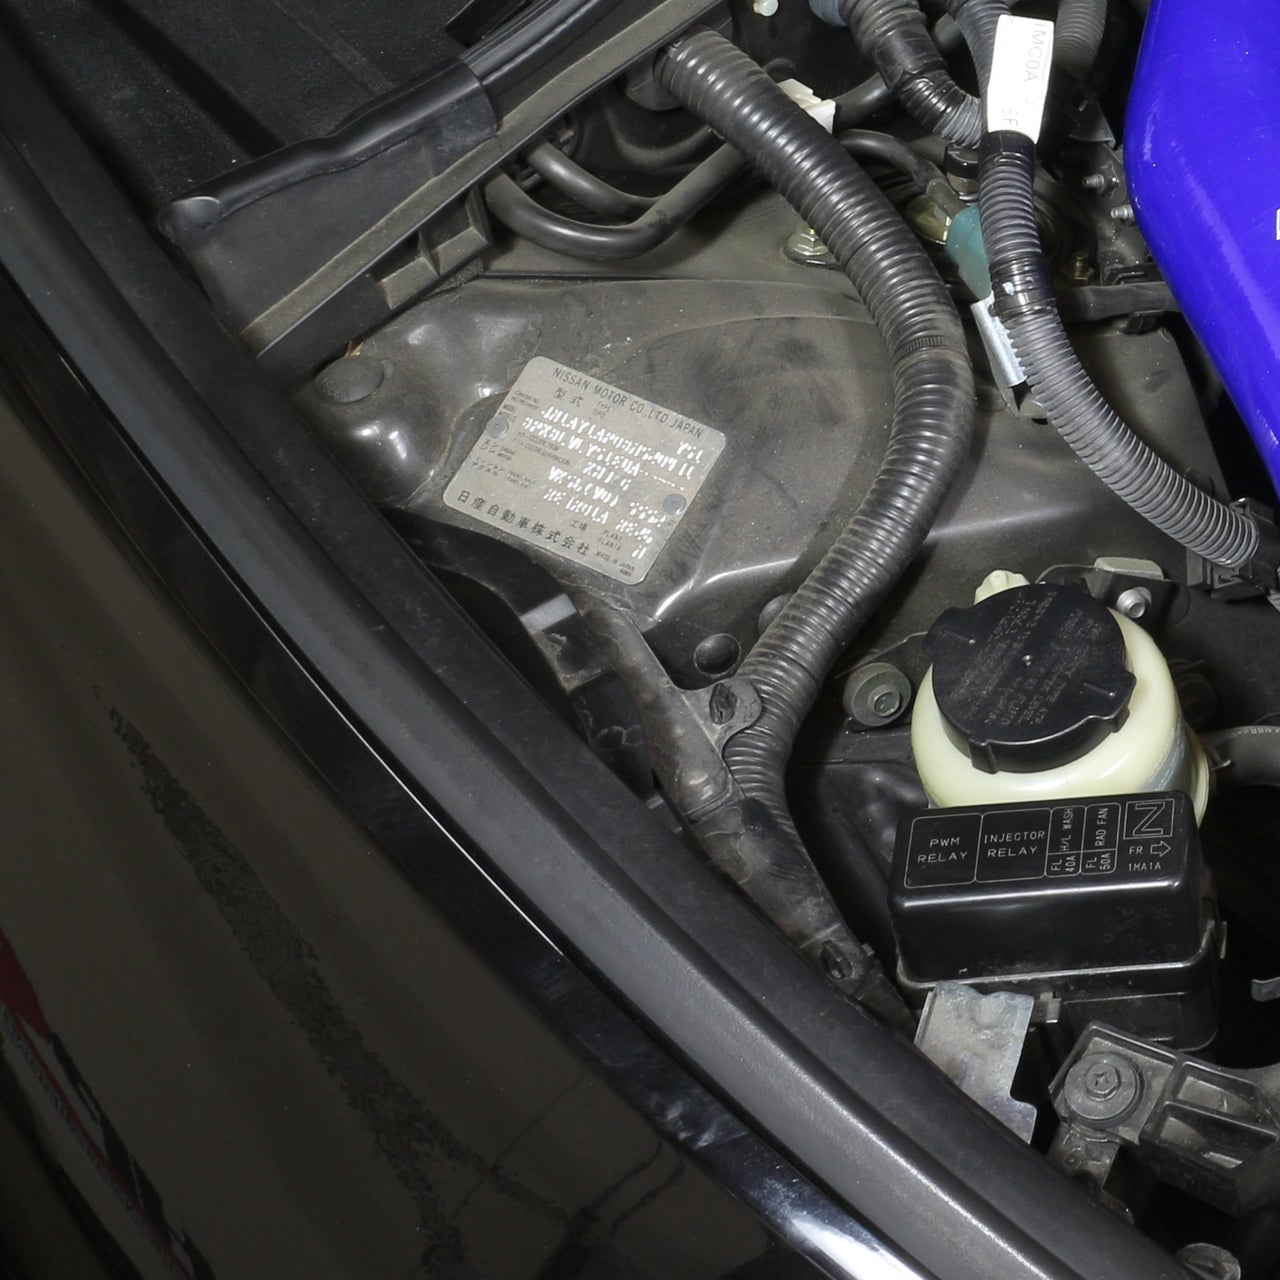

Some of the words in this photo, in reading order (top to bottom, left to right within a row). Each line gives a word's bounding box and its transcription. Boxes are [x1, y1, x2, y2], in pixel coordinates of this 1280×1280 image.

[551, 366, 590, 391] NISSAN
[591, 383, 627, 407] MOTOR
[669, 416, 704, 440] JAPAN
[456, 487, 591, 558] 日産自動車株式会社
[1061, 807, 1074, 831] WASH
[1096, 807, 1108, 824] FAN
[929, 836, 961, 847] PWM
[983, 829, 1045, 845] INJECTOR
[1060, 831, 1072, 852] H/L
[1094, 824, 1107, 847] RAD
[917, 850, 968, 863] RELAY
[987, 845, 1038, 858] RELAY
[1128, 845, 1143, 856] FR
[1051, 857, 1062, 871] FL
[1065, 854, 1077, 872] 40A
[1085, 855, 1097, 869] FL
[1099, 851, 1112, 870] 50A
